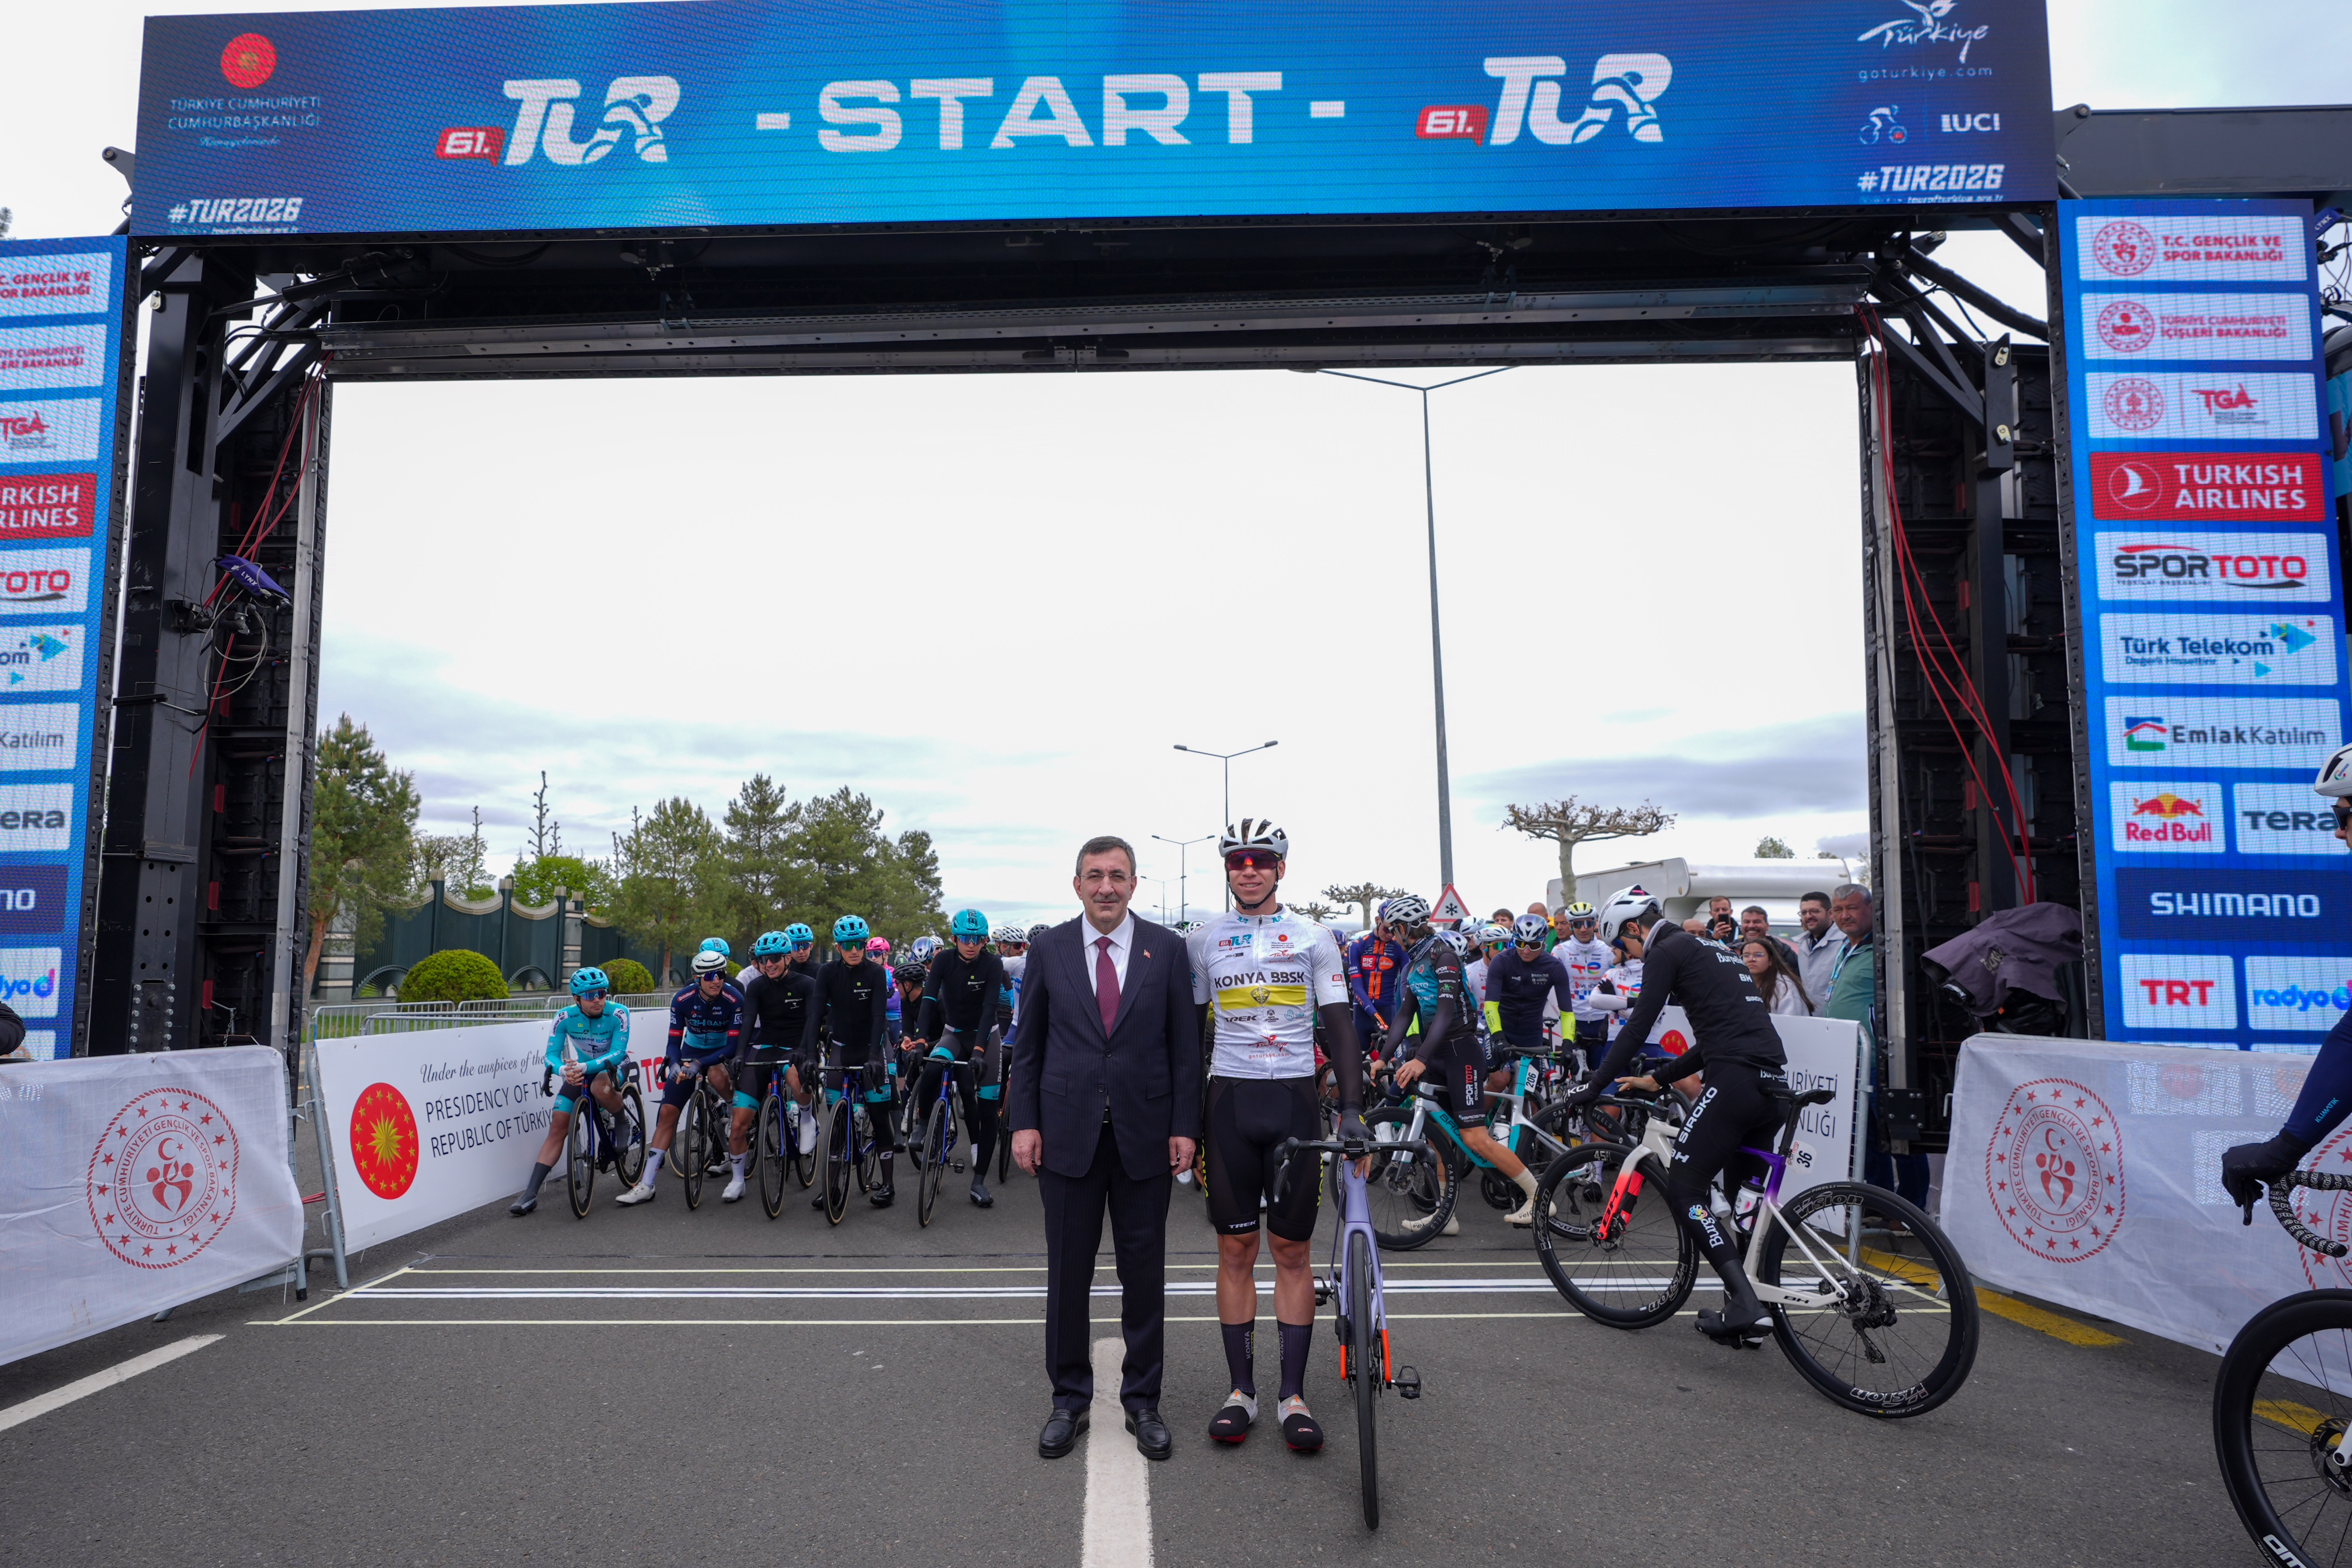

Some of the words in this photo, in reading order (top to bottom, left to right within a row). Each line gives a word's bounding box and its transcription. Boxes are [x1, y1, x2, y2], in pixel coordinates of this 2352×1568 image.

[1859, 67, 1992, 82] goturkiye.com
[170, 97, 223, 111] TÜRKİYE
[228, 95, 321, 110] CUMHURİYETİ
[445, 132, 491, 154] 61.
[503, 76, 681, 166] TUR
[817, 72, 1283, 153] START
[1425, 111, 1473, 133] 61.
[1483, 53, 1673, 145] TUR
[168, 113, 320, 130] CUMHURBAŞKANLIĞI
[1857, 164, 2005, 192] #TUR2026
[167, 197, 303, 223] #TUR2026
[2162, 236, 2190, 247] T.C.
[2193, 234, 2258, 249] GENÇLİK
[2263, 236, 2282, 247] VE
[2163, 251, 2202, 262] SPOR
[2205, 248, 2283, 261] BAKANLIĞI
[13, 272, 70, 285] GENÇLİK
[74, 271, 90, 282] VE
[22, 283, 90, 298] BAKANLIĞI
[2216, 326, 2287, 338] BAKANLIĞI
[22, 356, 84, 369] BAKANLIĞI
[2190, 383, 2258, 416] TGA
[0, 410, 50, 441] TGA
[2173, 464, 2303, 485] TURKISH
[2, 485, 79, 505] RKISH
[2174, 489, 2307, 509] AIRLINES
[240, 572, 258, 586] LYNX
[2120, 637, 2170, 654] Türk
[2177, 637, 2274, 655] Telekom
[2150, 892, 2321, 918] SHIMANO
[1214, 972, 1267, 988] KONYA
[1270, 971, 1305, 983] BBSK
[1738, 973, 1753, 983] BH
[2139, 979, 2214, 1006] TRT
[1484, 1040, 1492, 1060] NIPPO
[421, 1064, 457, 1083] Under
[459, 1059, 475, 1078] the
[477, 1057, 517, 1079] auspices
[520, 1051, 533, 1074] of
[532, 1049, 545, 1065] the
[1465, 1065, 1474, 1106] SPORTOTO
[1525, 1072, 1536, 1088] 206
[426, 1087, 509, 1123] PRESIDENCY
[514, 1083, 529, 1104] OF
[2314, 1097, 2339, 1123] KLIMATIK
[1678, 1087, 1718, 1144] SIROKO
[2039, 1109, 2077, 1130] GENÇLİK
[153, 1119, 190, 1134] GENÇLİK
[190, 1129, 200, 1143] VE
[430, 1123, 494, 1158] REPUBLIC
[497, 1120, 512, 1140] OF
[514, 1107, 554, 1134] TÜRKİY
[2076, 1127, 2086, 1143] VE
[2013, 1110, 2040, 1177] CUMHURİYETİ
[119, 1125, 153, 1203] CUMHURİYETİ
[199, 1142, 213, 1169] SPOR
[1797, 1150, 1813, 1168] 36
[2083, 1144, 2099, 1177] SPOR
[183, 1171, 216, 1227] BAKANLIĞI
[1811, 1185, 1836, 1193] PIRELLI
[2014, 1179, 2042, 1222] TÜRKİYE
[2066, 1180, 2100, 1228] BAKANLIĞI
[124, 1204, 159, 1236] TÜRKİYE
[1228, 1219, 1257, 1229] TREK
[1430, 1202, 1450, 1231] WHEELS
[1783, 1295, 1810, 1304] BH
